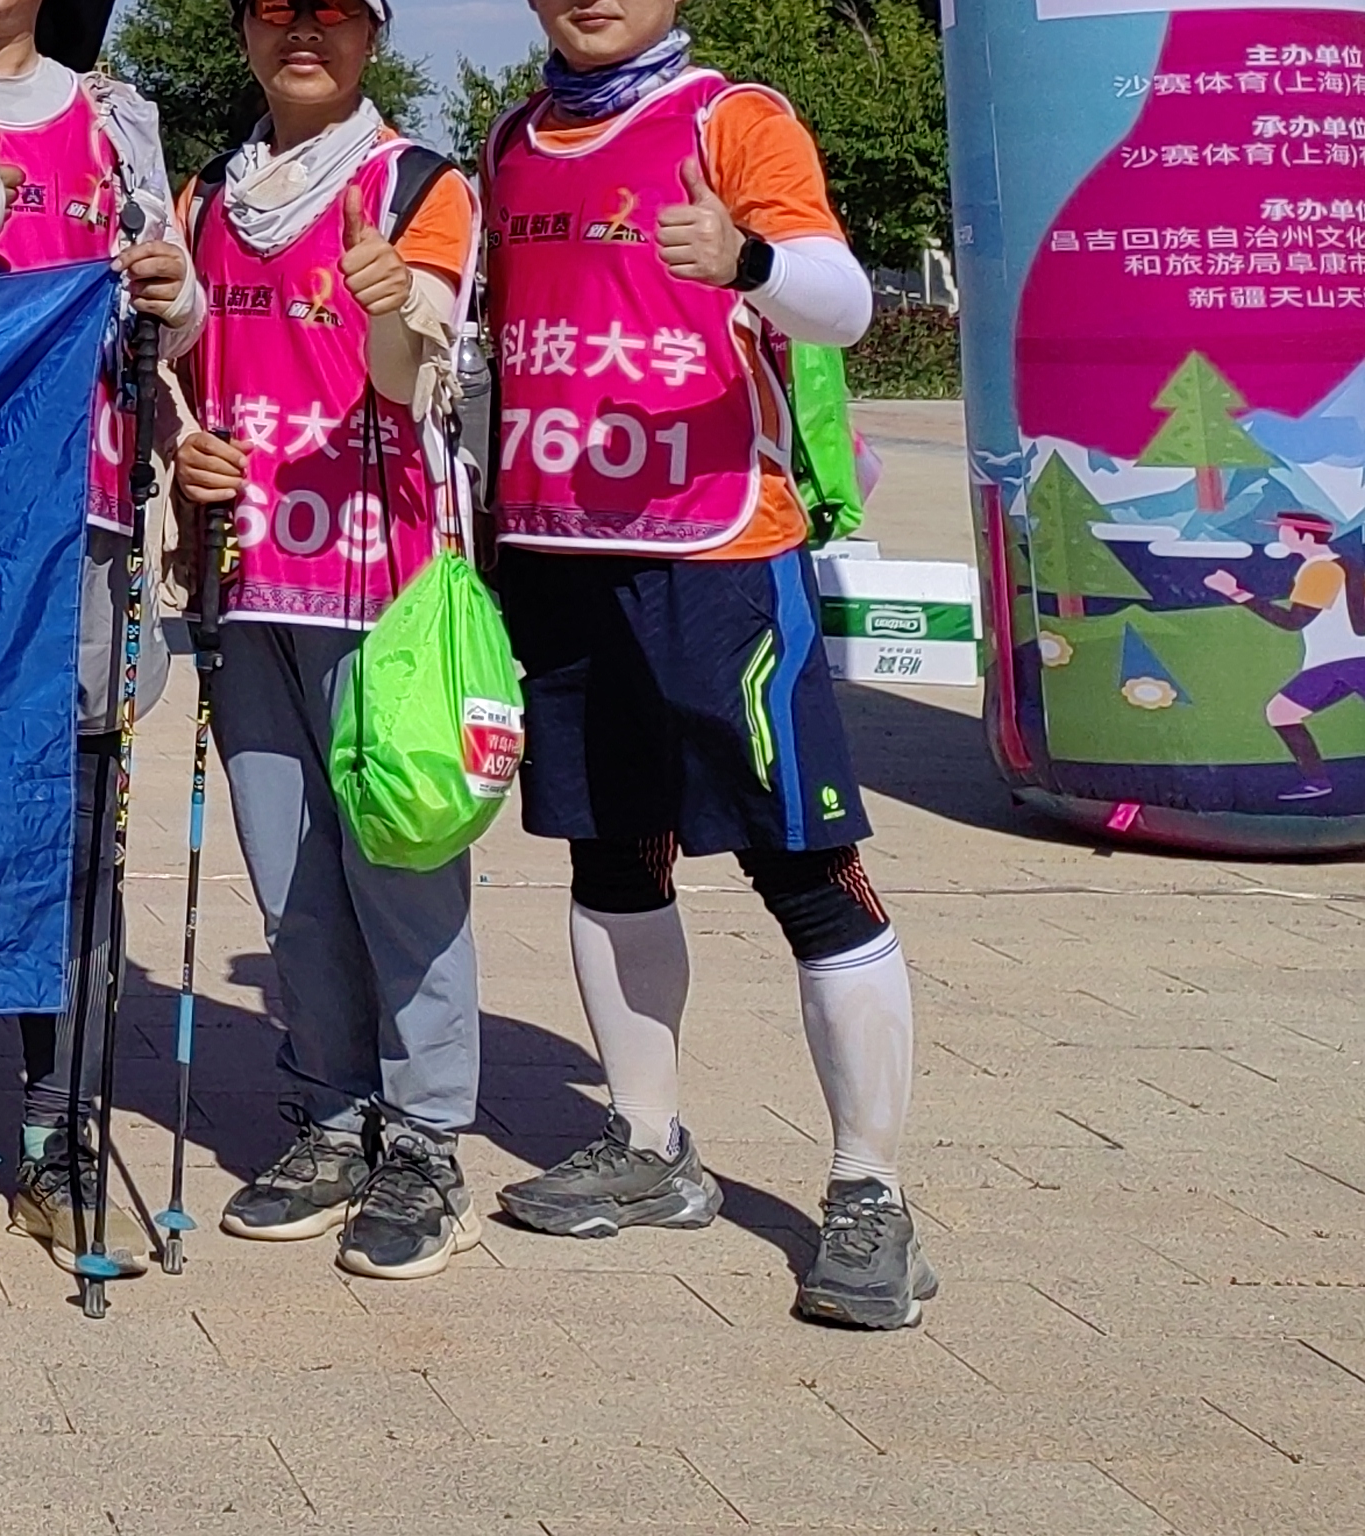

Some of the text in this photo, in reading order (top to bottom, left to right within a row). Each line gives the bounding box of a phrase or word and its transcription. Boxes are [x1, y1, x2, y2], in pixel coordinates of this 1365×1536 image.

[1244, 43, 1363, 69] 主办单位
[1120, 142, 1365, 169] 沙赛体育(上海)
[1188, 285, 1365, 310] 新疆天山天
[501, 317, 707, 386] 科技大学
